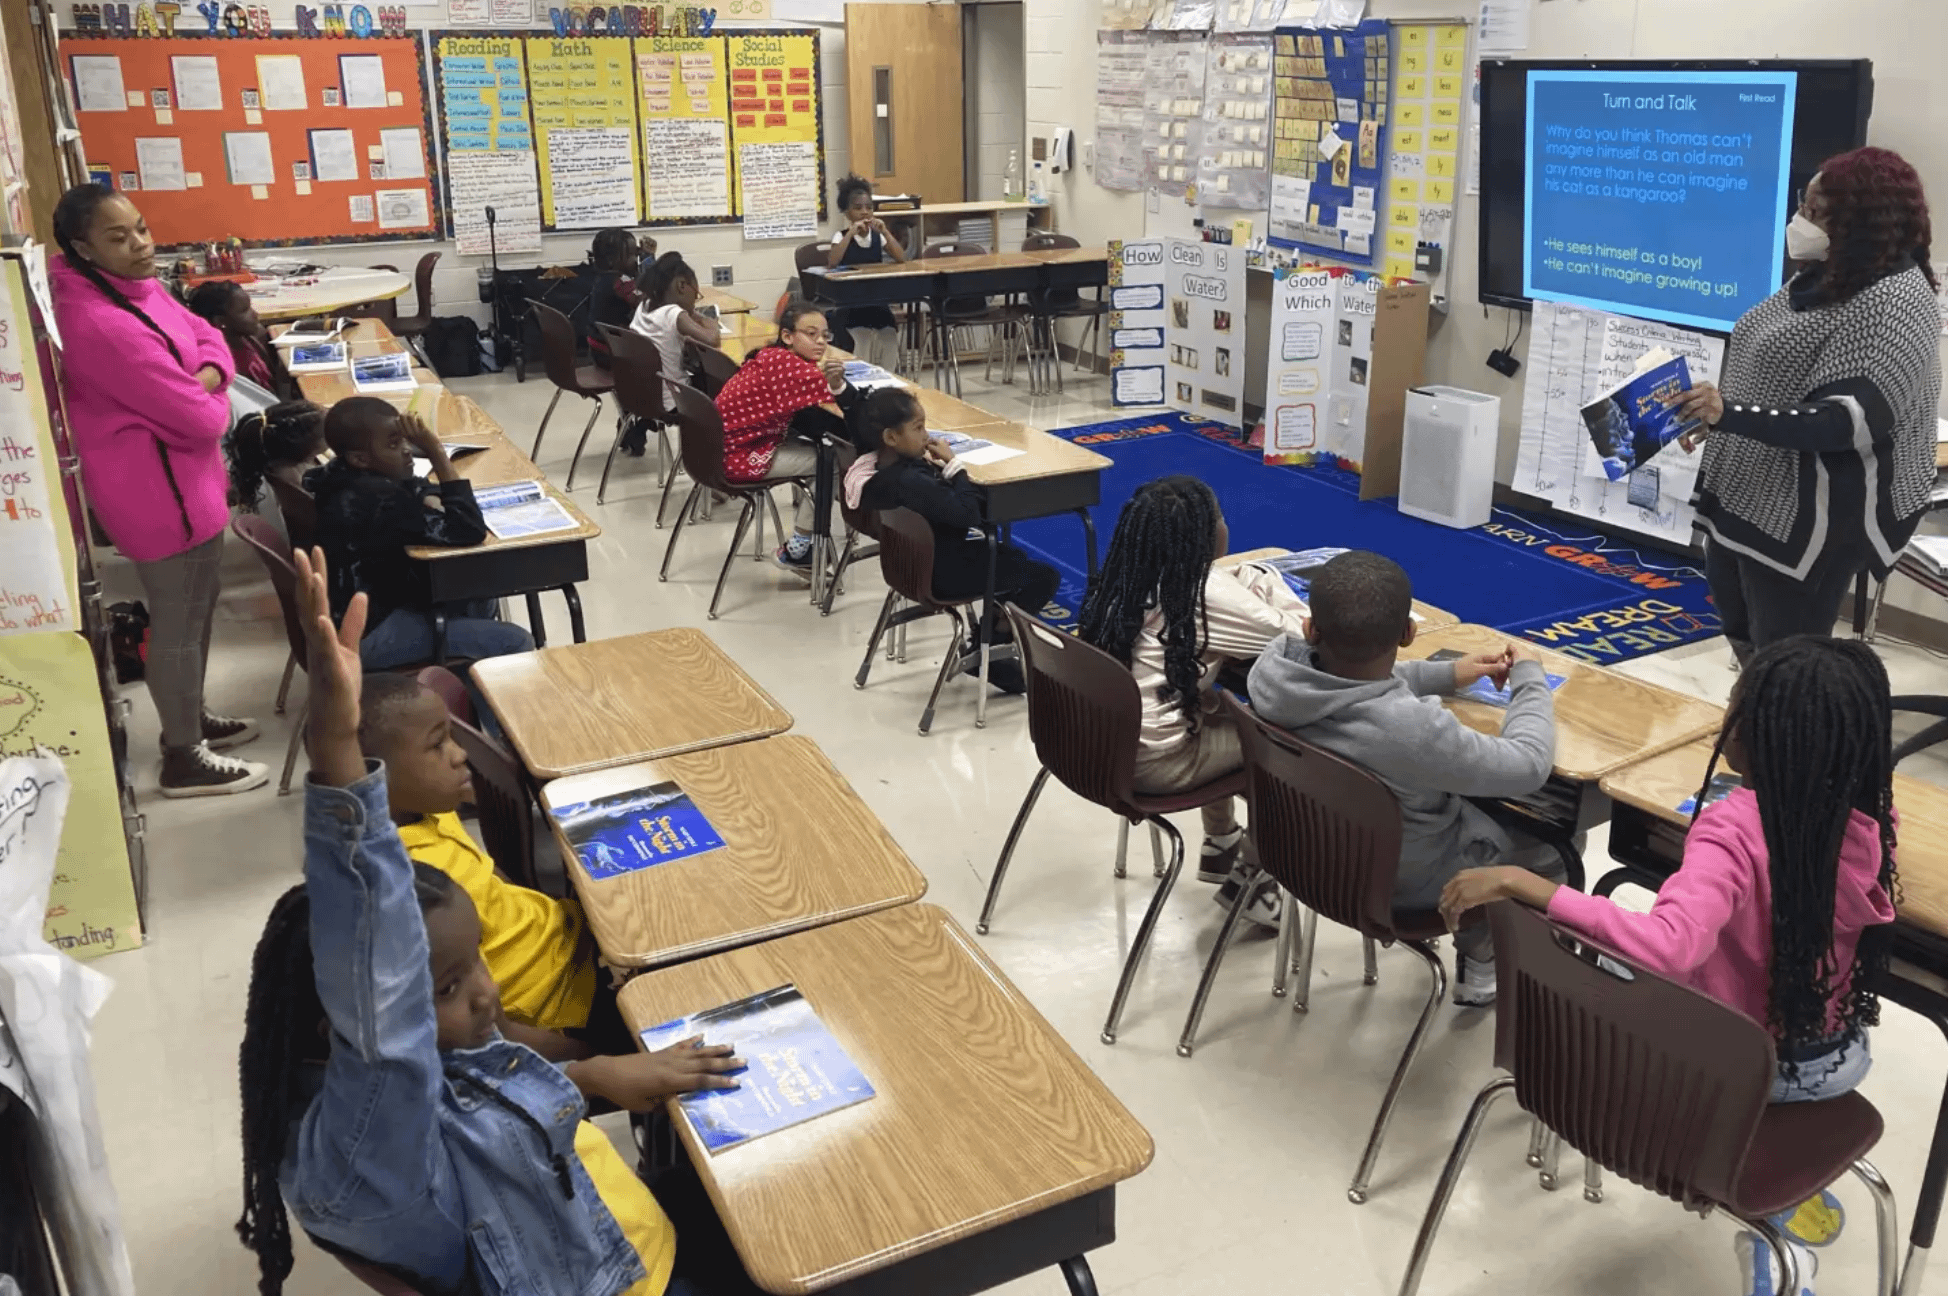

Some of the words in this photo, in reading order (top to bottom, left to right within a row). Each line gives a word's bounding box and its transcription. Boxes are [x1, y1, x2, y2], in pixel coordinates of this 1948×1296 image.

[72, 2, 181, 38] WHAT
[198, 2, 273, 38] YOU
[294, 4, 407, 40] KNOW
[549, 6, 717, 37] VOCABULARY
[447, 40, 511, 57] Reading
[551, 41, 592, 57] Math
[653, 38, 704, 52] Science
[743, 38, 783, 52] Social
[735, 52, 785, 66] Studies
[1603, 93, 1631, 109] Turn
[1635, 95, 1664, 110] and
[1668, 94, 1697, 111] Talk
[1739, 93, 1752, 103] First
[1754, 94, 1776, 103] Read
[1546, 124, 1571, 140] Why
[1574, 126, 1591, 140] do
[1594, 130, 1617, 143] you
[1621, 127, 1651, 143] think
[1655, 129, 1707, 146] Thomas
[1712, 133, 1752, 149] can't
[1546, 140, 1593, 159] imagine
[1596, 145, 1640, 160] himself
[1643, 149, 1658, 162] as
[1661, 150, 1680, 163] an
[1683, 149, 1706, 165] old
[1710, 154, 1743, 167] man
[1545, 164, 1567, 177] any
[1570, 166, 1602, 179] more
[1605, 166, 1634, 181] than
[1637, 168, 1655, 183] he
[1657, 172, 1685, 186] can
[1688, 171, 1748, 193] imagine
[1545, 178, 1560, 191] his
[1562, 181, 1582, 194] cat
[1586, 184, 1600, 196] as
[1602, 186, 1612, 196] a
[1615, 184, 1687, 203] kangaroo?
[1125, 249, 1162, 262] How
[1171, 246, 1202, 263] Clean
[1217, 253, 1226, 268] Is
[1567, 241, 1593, 256] sees
[1595, 243, 1639, 262] himself
[1641, 252, 1655, 264] as
[1658, 254, 1669, 266] a
[1672, 253, 1702, 272] boy!
[1186, 277, 1226, 297] Water?
[1289, 272, 1328, 288] Good
[1343, 273, 1355, 286] to
[1567, 261, 1599, 276] can't
[1601, 263, 1653, 284] imagine
[1655, 275, 1711, 296] growing
[1714, 282, 1738, 299] up!
[1285, 294, 1331, 310] Which
[1343, 296, 1376, 313] Water
[1608, 320, 1640, 336] Success
[1671, 332, 1702, 348] Writing
[1605, 350, 1633, 363] when
[20, 497, 42, 520] to
[24, 598, 65, 628] what
[1525, 599, 1684, 641] DREAM
